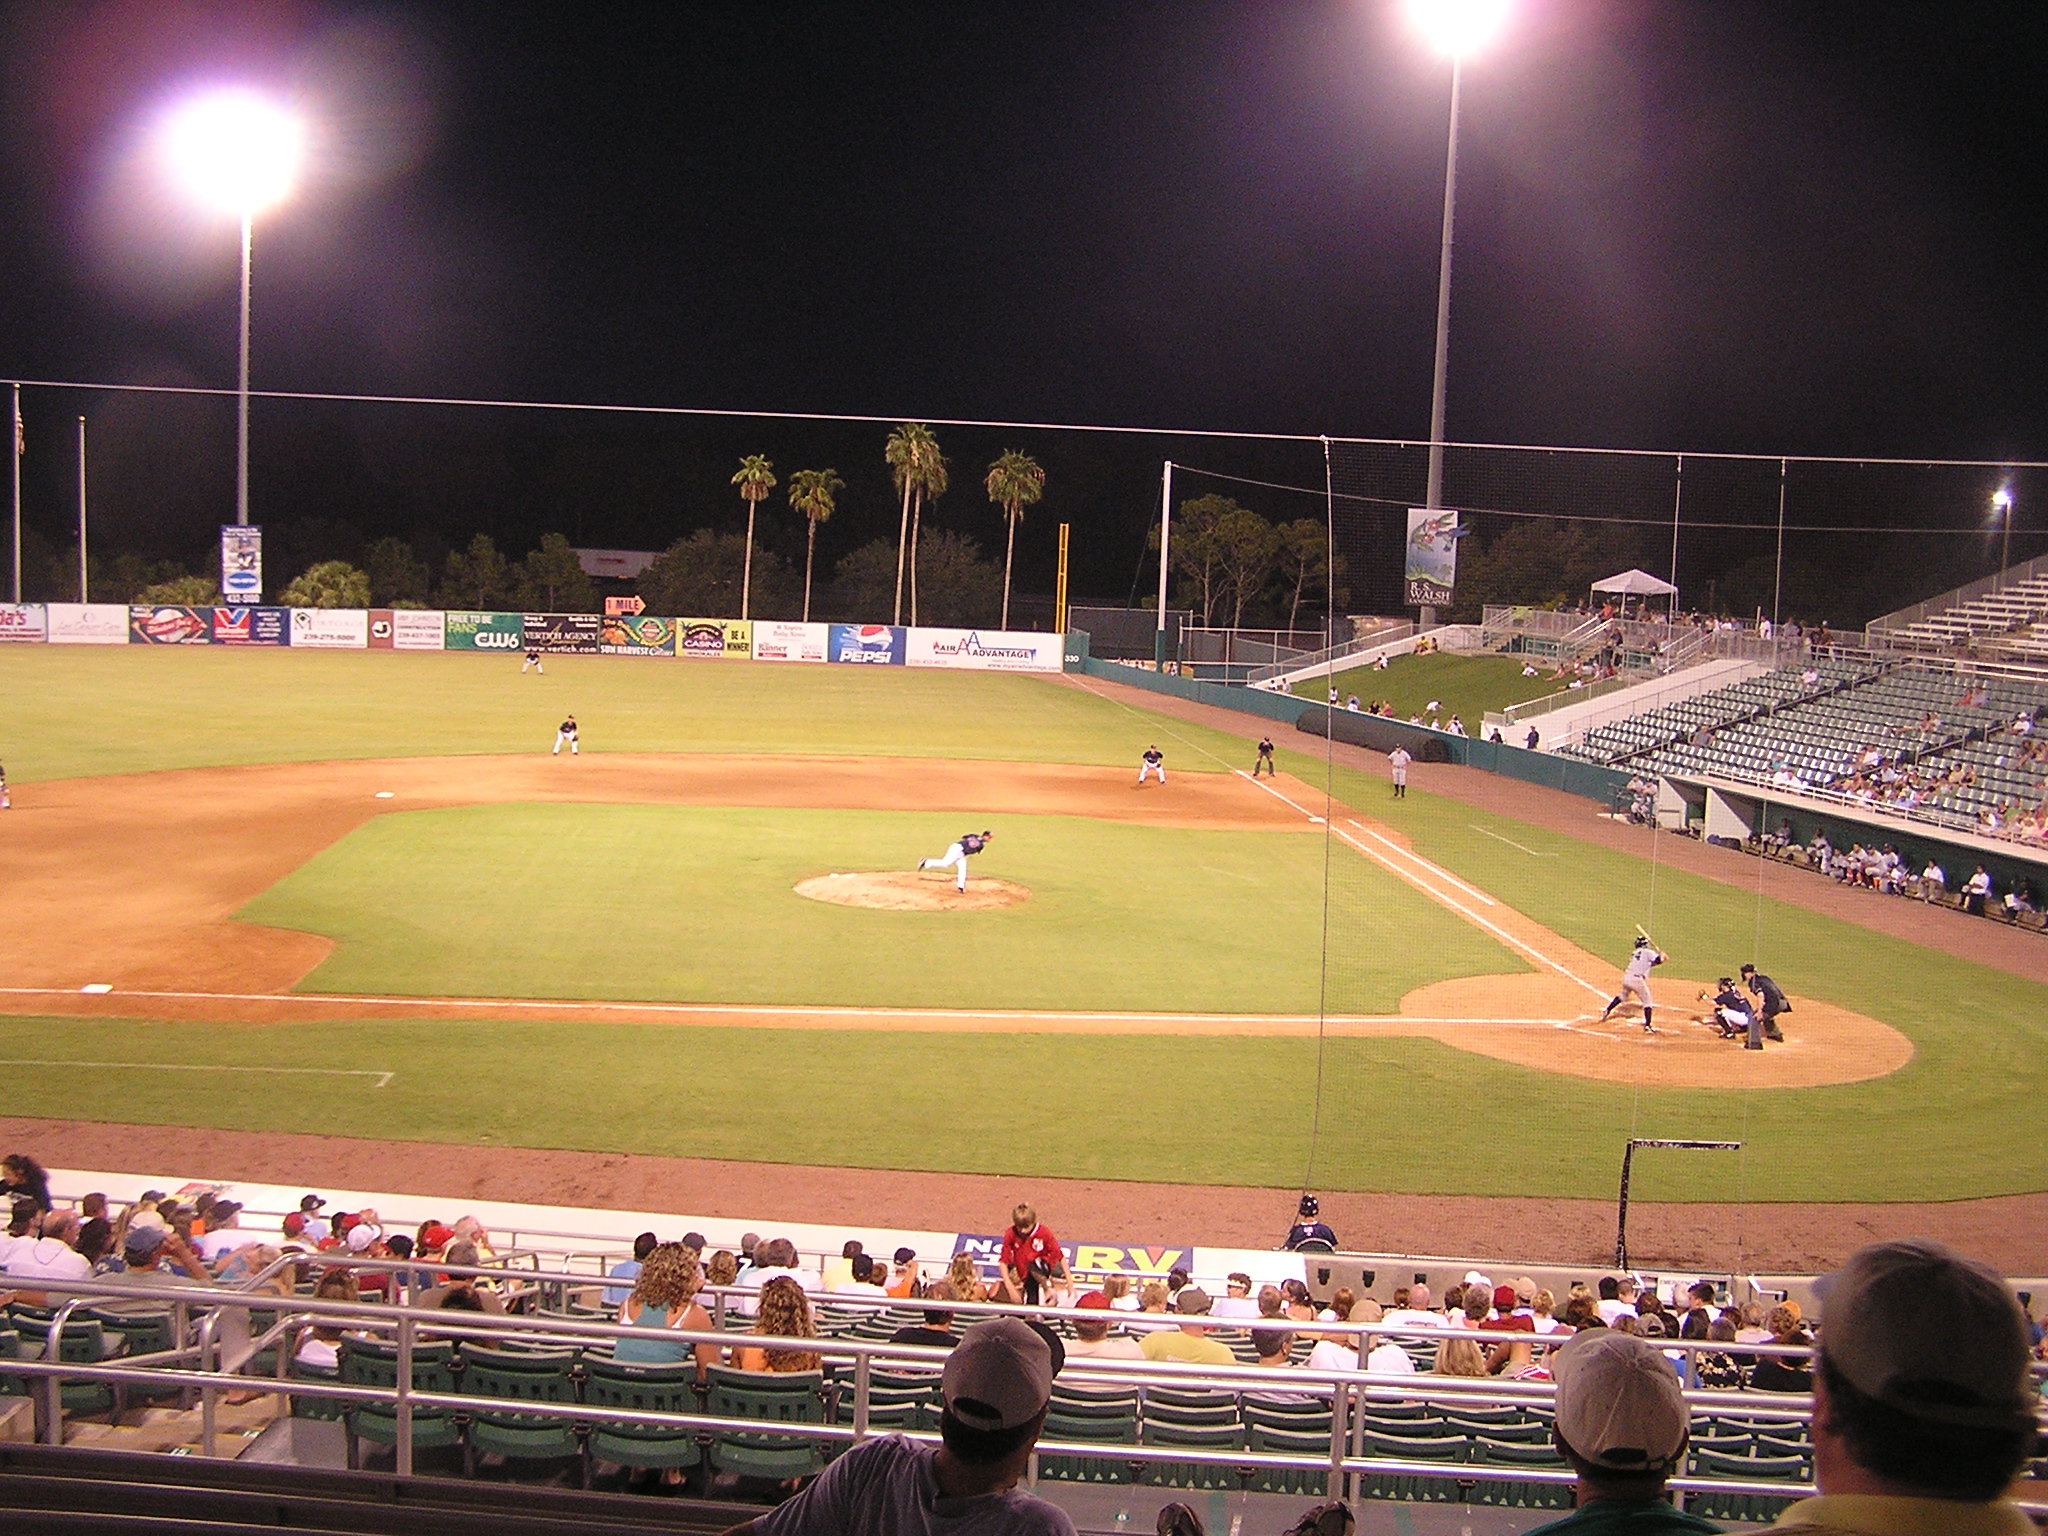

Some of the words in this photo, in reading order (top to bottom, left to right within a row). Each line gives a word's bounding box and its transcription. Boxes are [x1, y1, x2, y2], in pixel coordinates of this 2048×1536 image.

[1410, 590, 1450, 600] WALSH
[607, 600, 612, 609] 1
[615, 599, 640, 610] MILE
[470, 615, 480, 623] TO
[482, 615, 493, 624] BE
[447, 622, 477, 634] FANS
[474, 632, 519, 648] CW6
[563, 632, 598, 640] AGENCY
[731, 630, 739, 641] BE
[741, 630, 746, 640] A
[524, 645, 597, 653] www.vertich.com
[684, 640, 723, 649] CASINO
[727, 642, 750, 653] WINNER!
[600, 645, 616, 654] SUN
[617, 645, 649, 656] HARVEST
[972, 649, 1030, 659] ADVANTAGE
[839, 649, 892, 664] PEPSI
[1065, 655, 1079, 663] 330
[1075, 1245, 1183, 1272] RV
